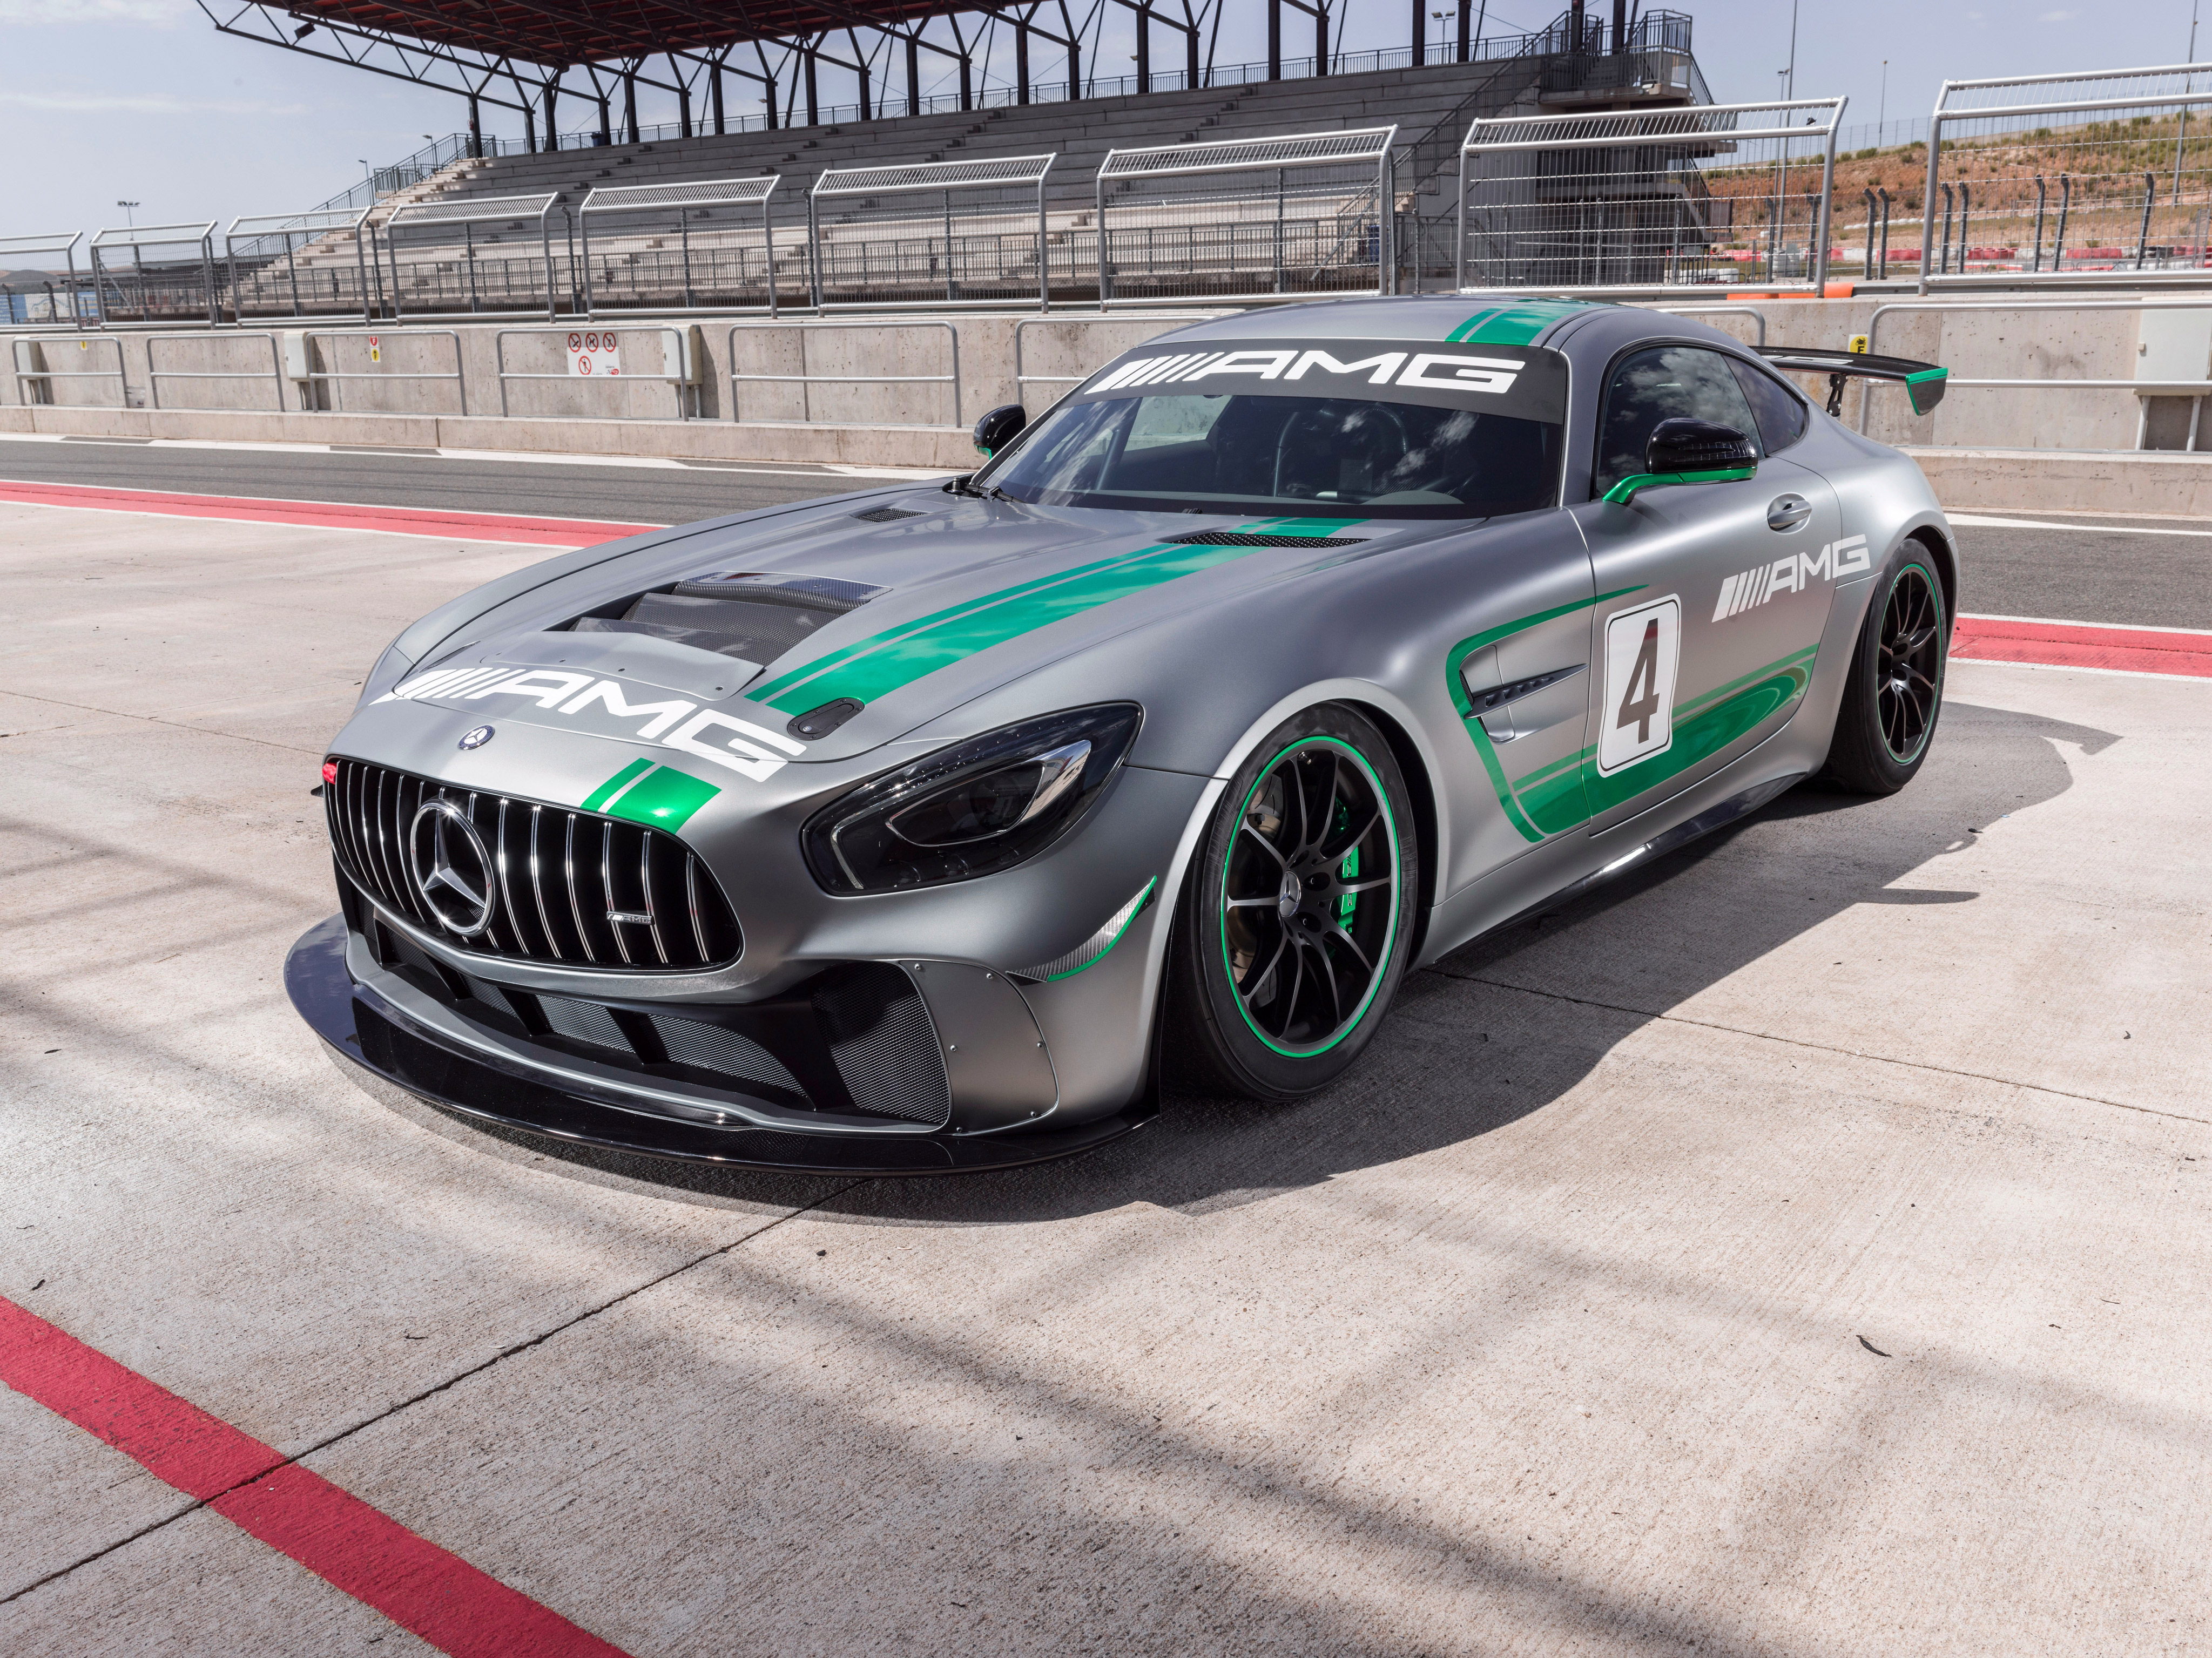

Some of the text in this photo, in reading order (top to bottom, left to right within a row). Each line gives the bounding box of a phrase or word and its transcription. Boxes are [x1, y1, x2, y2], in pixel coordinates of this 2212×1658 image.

[1182, 350, 1526, 394] AMG
[1763, 533, 1871, 603] AMG
[1616, 618, 1660, 744] 4
[470, 668, 806, 782] AMG
[622, 915, 651, 924] AMG
